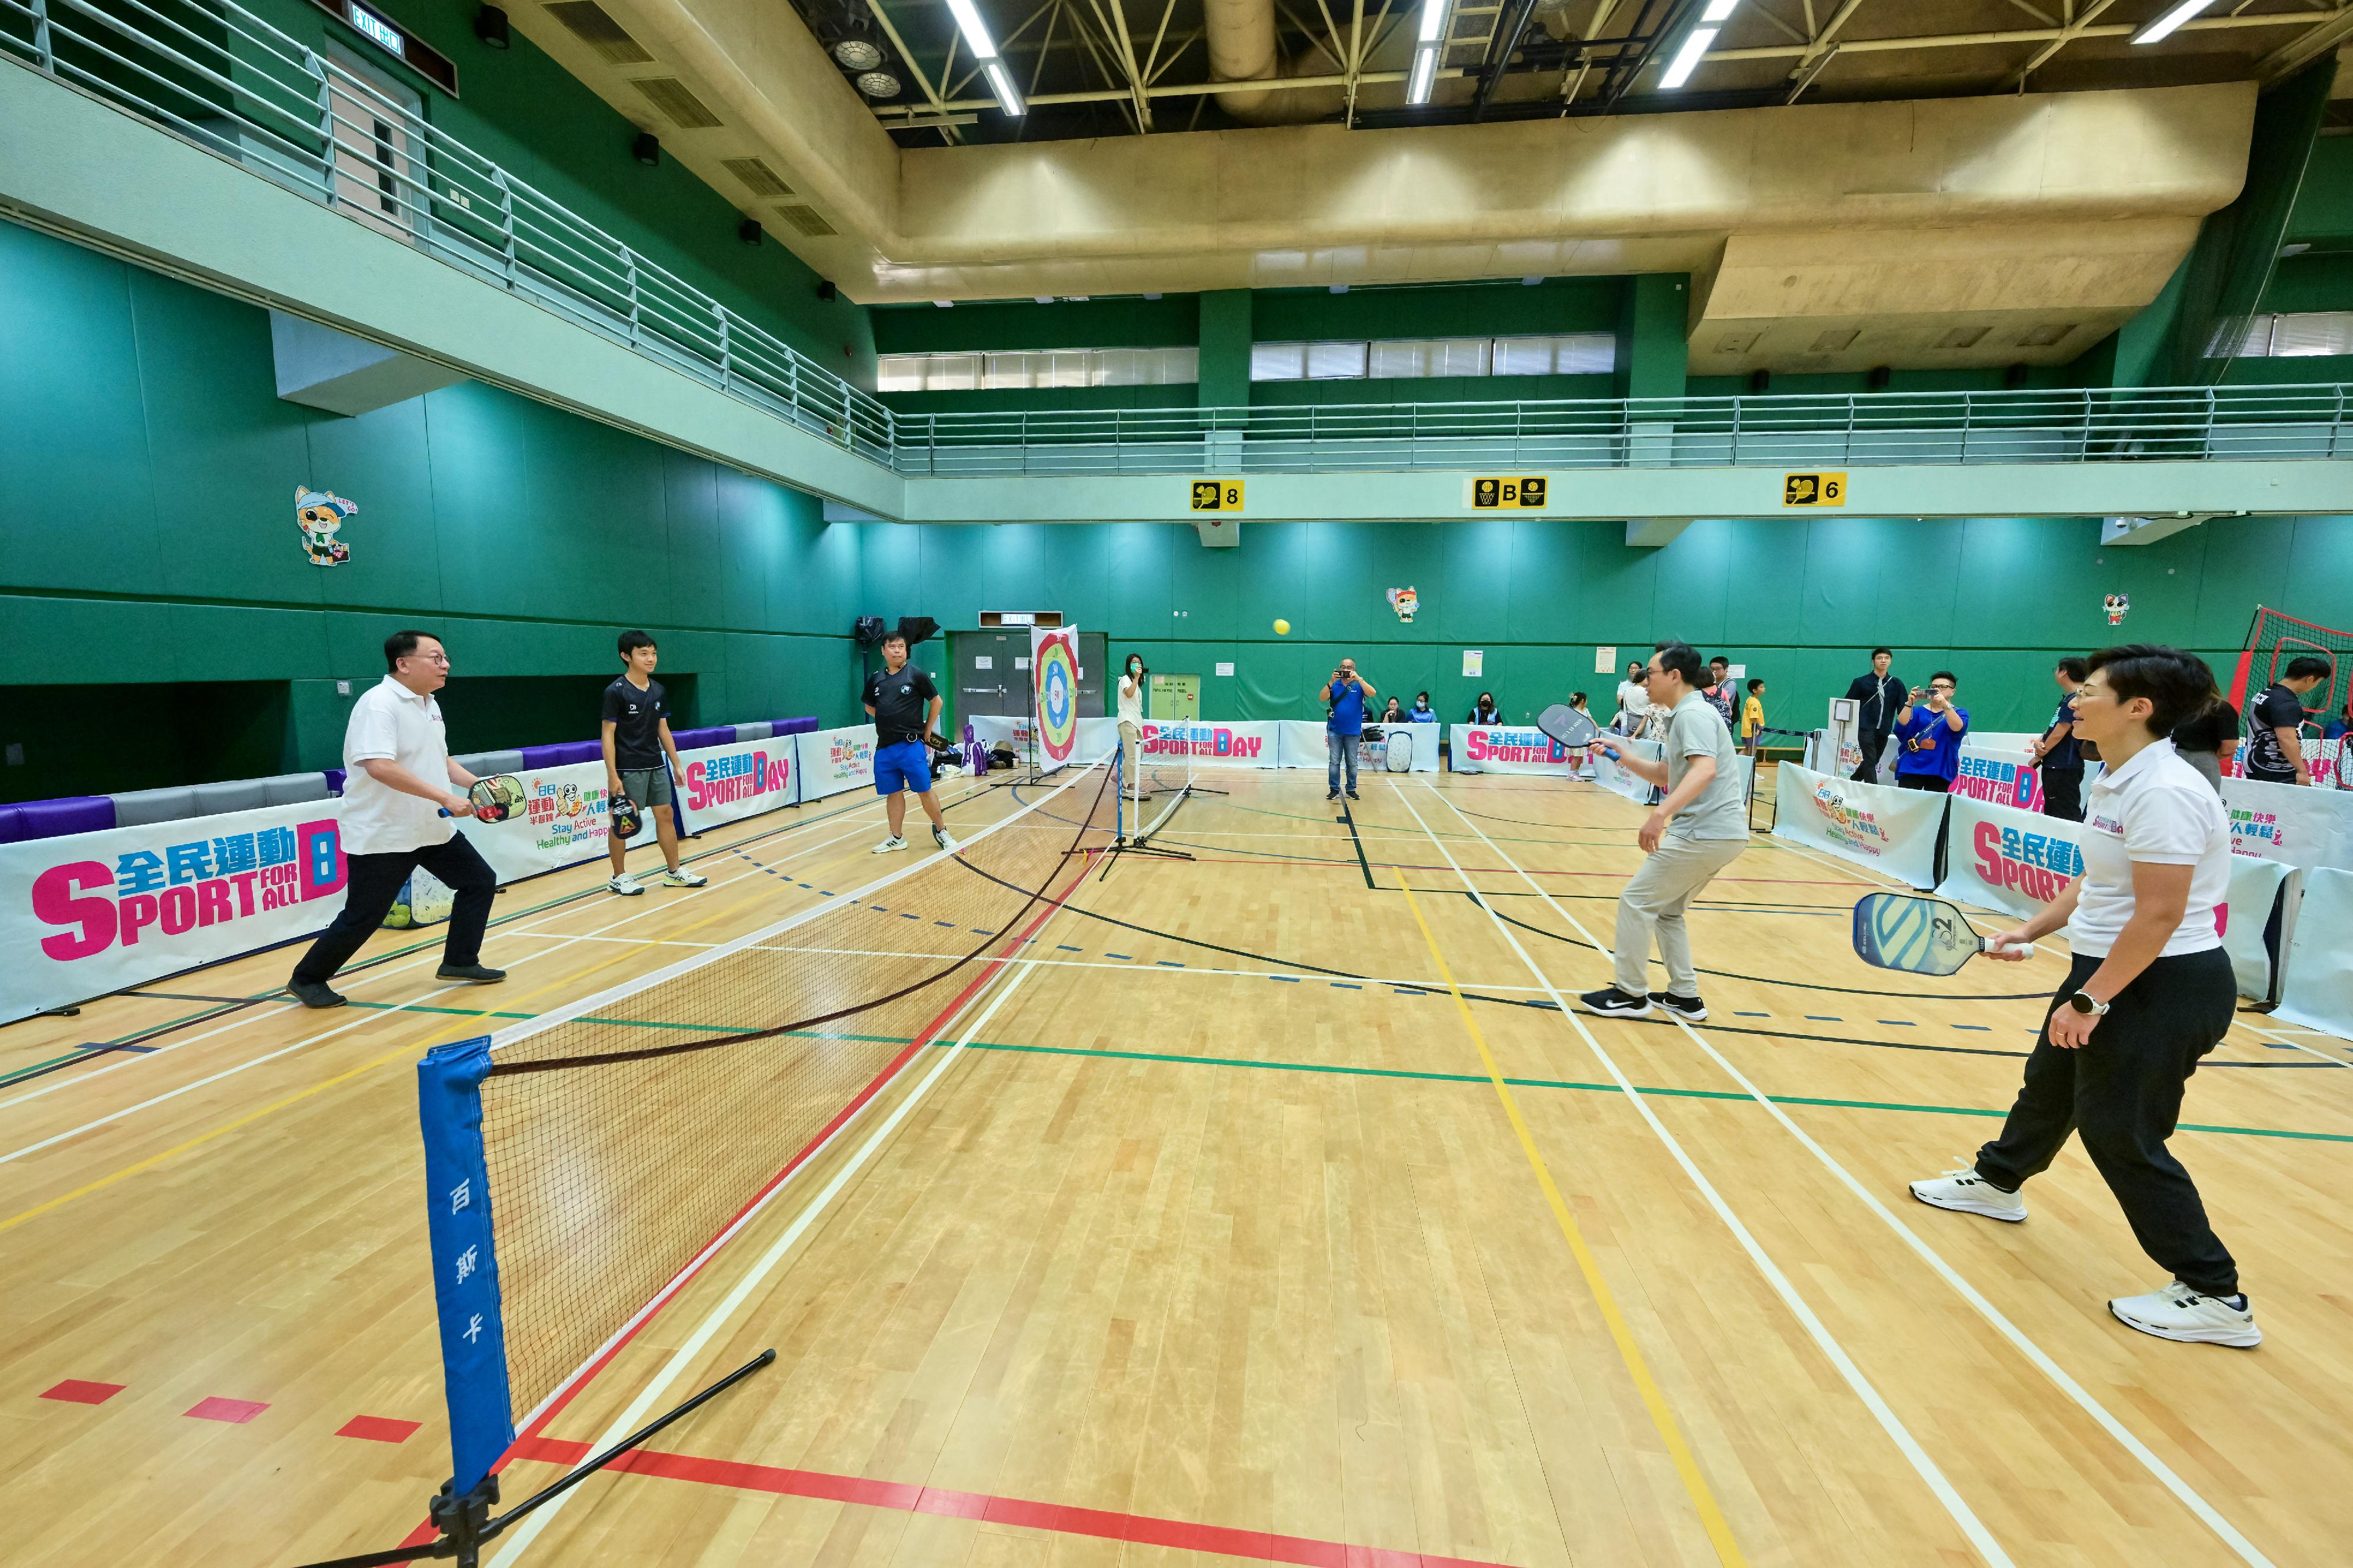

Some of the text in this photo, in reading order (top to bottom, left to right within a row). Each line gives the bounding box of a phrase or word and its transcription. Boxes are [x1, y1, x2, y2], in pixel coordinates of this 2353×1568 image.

[354, 7, 376, 36] EXIT
[380, 24, 401, 54] 出口
[1227, 489, 1238, 504] 8
[1503, 485, 1517, 501] B
[1826, 482, 1838, 498] 6
[339, 499, 355, 507] LET'S
[1004, 615, 1018, 623] EXIT
[1052, 663, 1058, 674] 30
[1054, 690, 1059, 700] 50
[1142, 725, 1199, 755] SPORT
[1214, 728, 1262, 758] DAY
[1467, 730, 1547, 763] SPORT FOR ALL
[1489, 732, 1548, 747] 全民運動
[1058, 748, 1064, 759] 10
[706, 753, 753, 781] 全民運動
[833, 771, 848, 780] Healthy
[1960, 756, 2016, 783] 全民運動
[686, 750, 789, 811] SPORT FOR ALL DAY
[1998, 782, 2013, 794] FOR
[2011, 765, 2045, 813] DA
[538, 784, 556, 796] 日日
[584, 789, 608, 802] 健康快
[528, 796, 555, 815] 運動
[587, 800, 610, 815] 人輕
[1995, 793, 2011, 806] ALL
[530, 813, 554, 825] 半個鐘
[2230, 809, 2277, 825] 健康快樂
[552, 818, 596, 835] Stay Active
[1845, 828, 1864, 840] Active
[2230, 822, 2275, 839] 人輕鬆
[536, 835, 571, 850] Healthy
[572, 829, 588, 842] and
[1826, 828, 1848, 845] Healthy
[1859, 842, 1881, 856] Happy
[115, 826, 296, 897] 全民運動
[1974, 820, 2071, 903] SPORT
[260, 863, 298, 889] FOR
[262, 883, 299, 912] ALL
[32, 860, 258, 962] SPORT
[449, 1177, 484, 1345] 百斯卡
